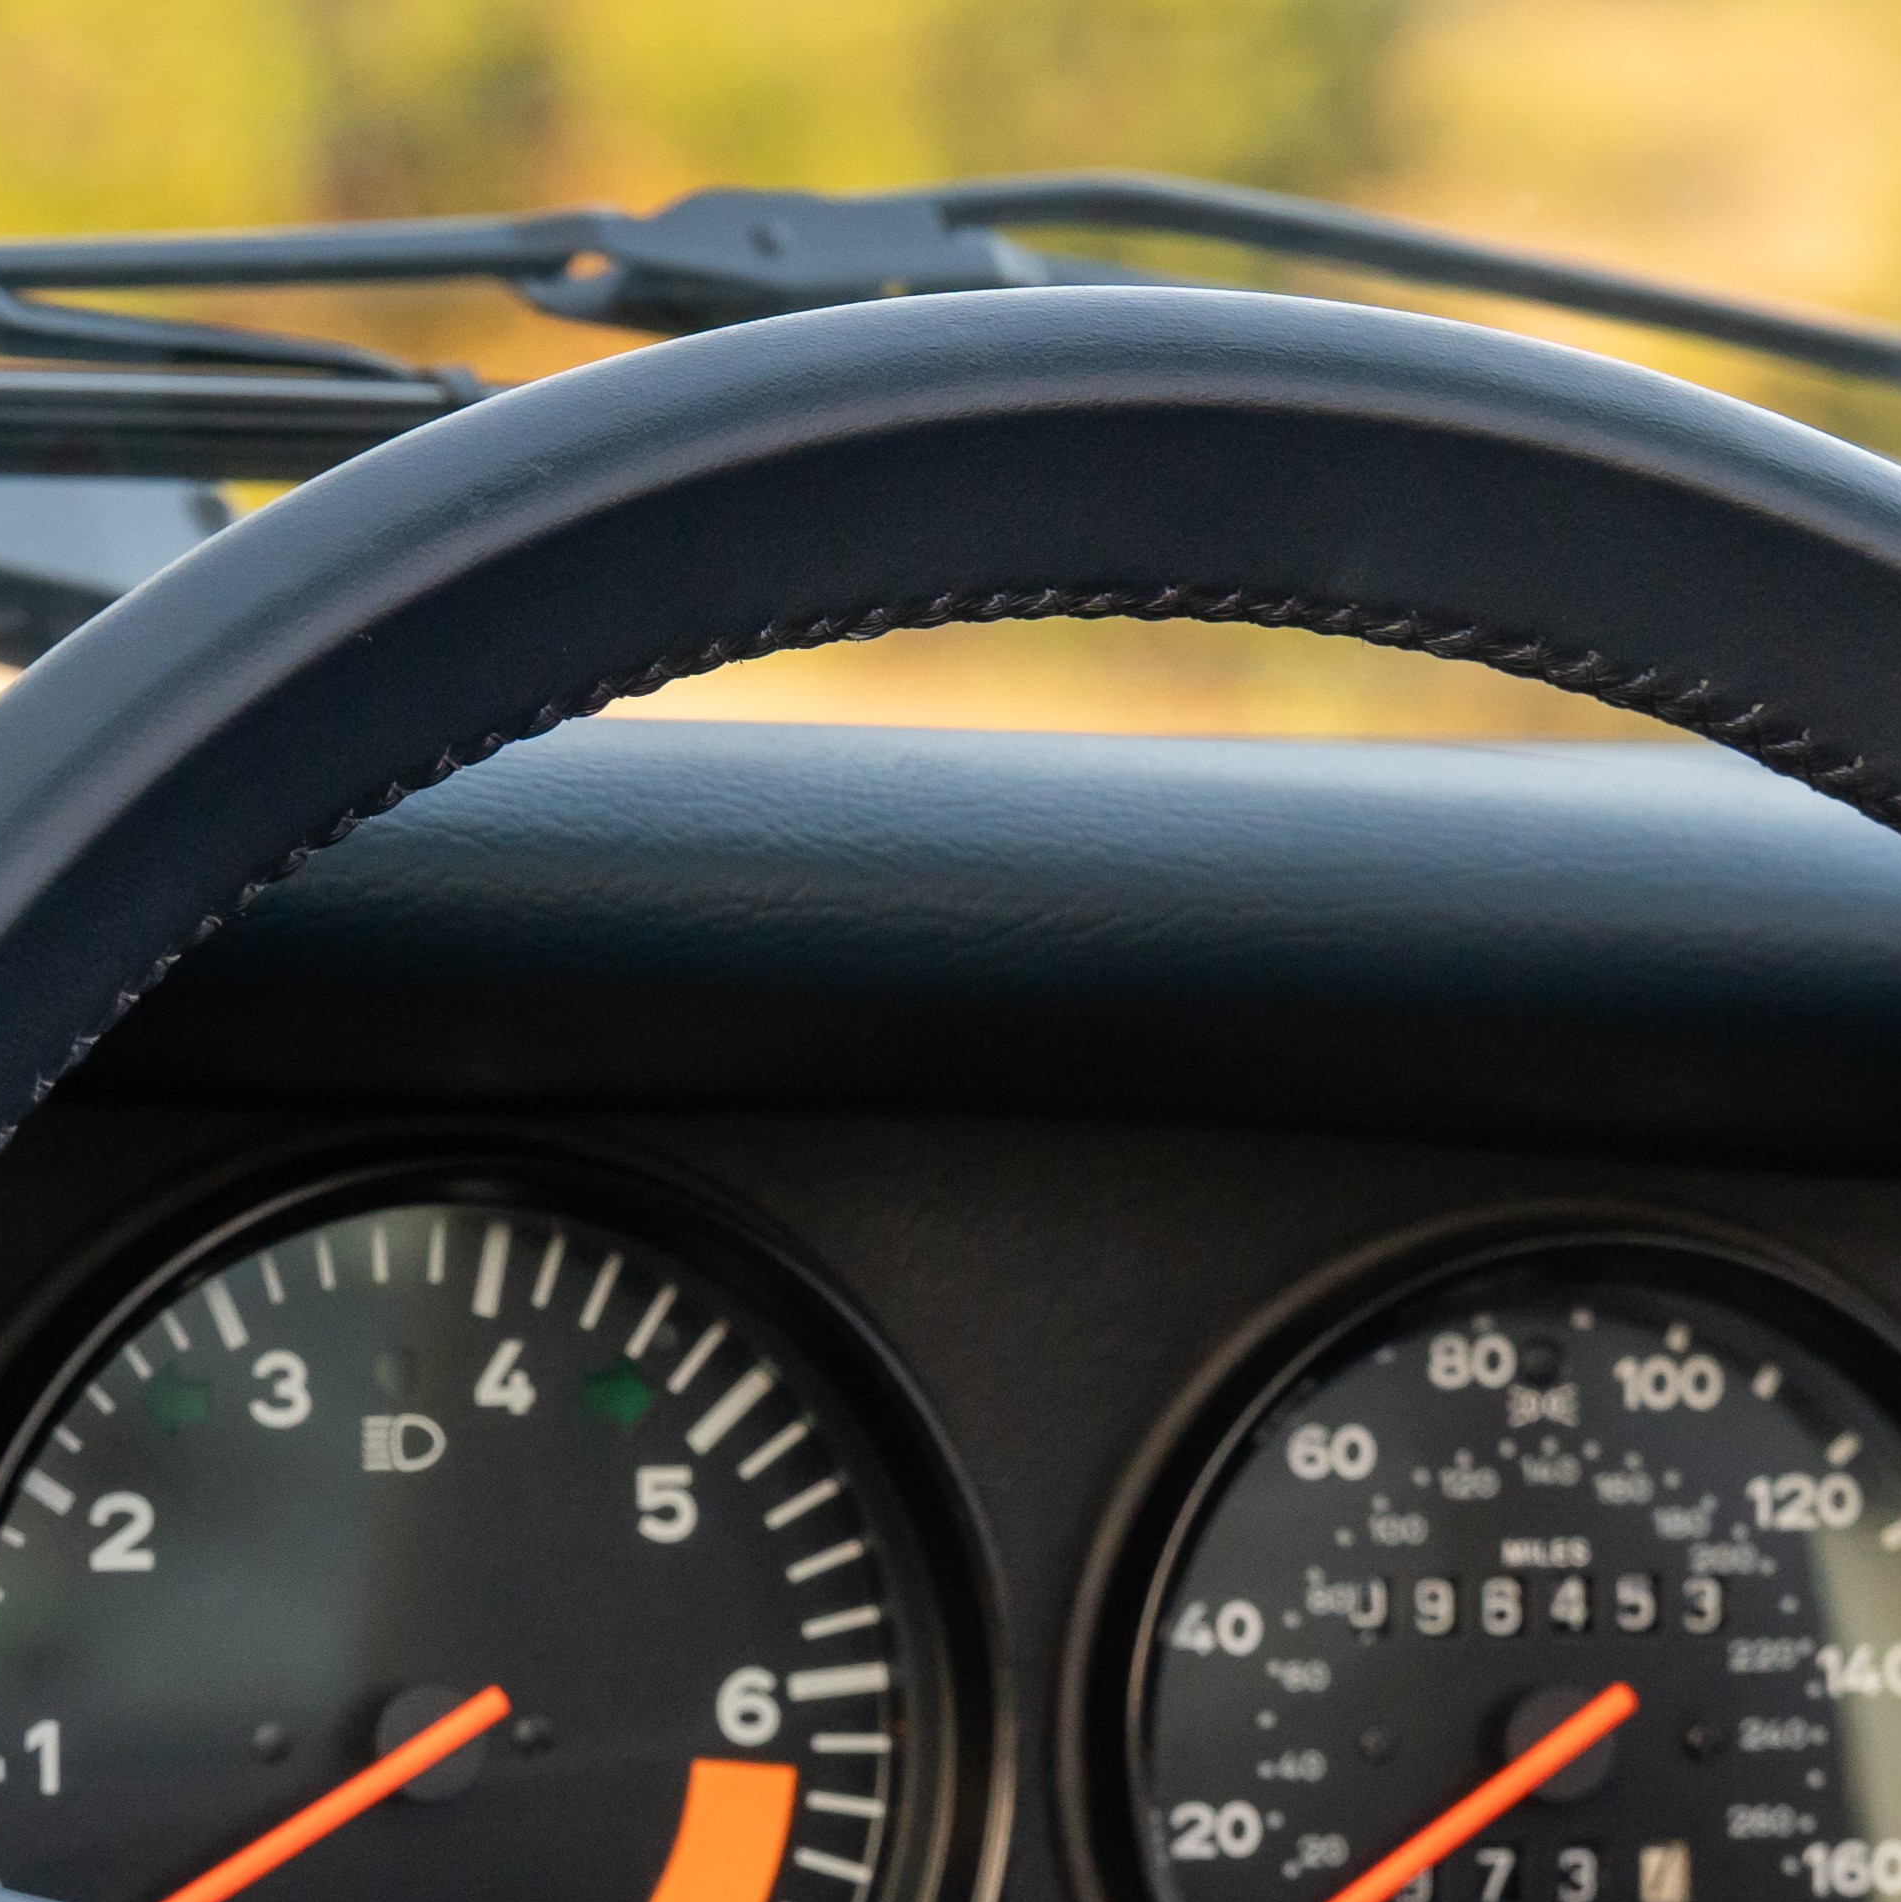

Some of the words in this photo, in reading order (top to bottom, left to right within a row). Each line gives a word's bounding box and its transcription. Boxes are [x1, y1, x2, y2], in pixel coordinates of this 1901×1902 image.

[250, 1351, 311, 1428] 3
[475, 1340, 535, 1415] 4
[1428, 1331, 1517, 1391] 80
[1614, 1356, 1723, 1411] 100
[1287, 1425, 1377, 1480] 60
[90, 1492, 155, 1572] 2
[637, 1466, 697, 1543] 5
[1746, 1475, 1861, 1531] 120
[1502, 1538, 1590, 1567] MILES
[1173, 1600, 1263, 1656] 40
[716, 1667, 780, 1746] 6
[25, 1720, 59, 1794] 1
[1171, 1801, 1262, 1858] 20
